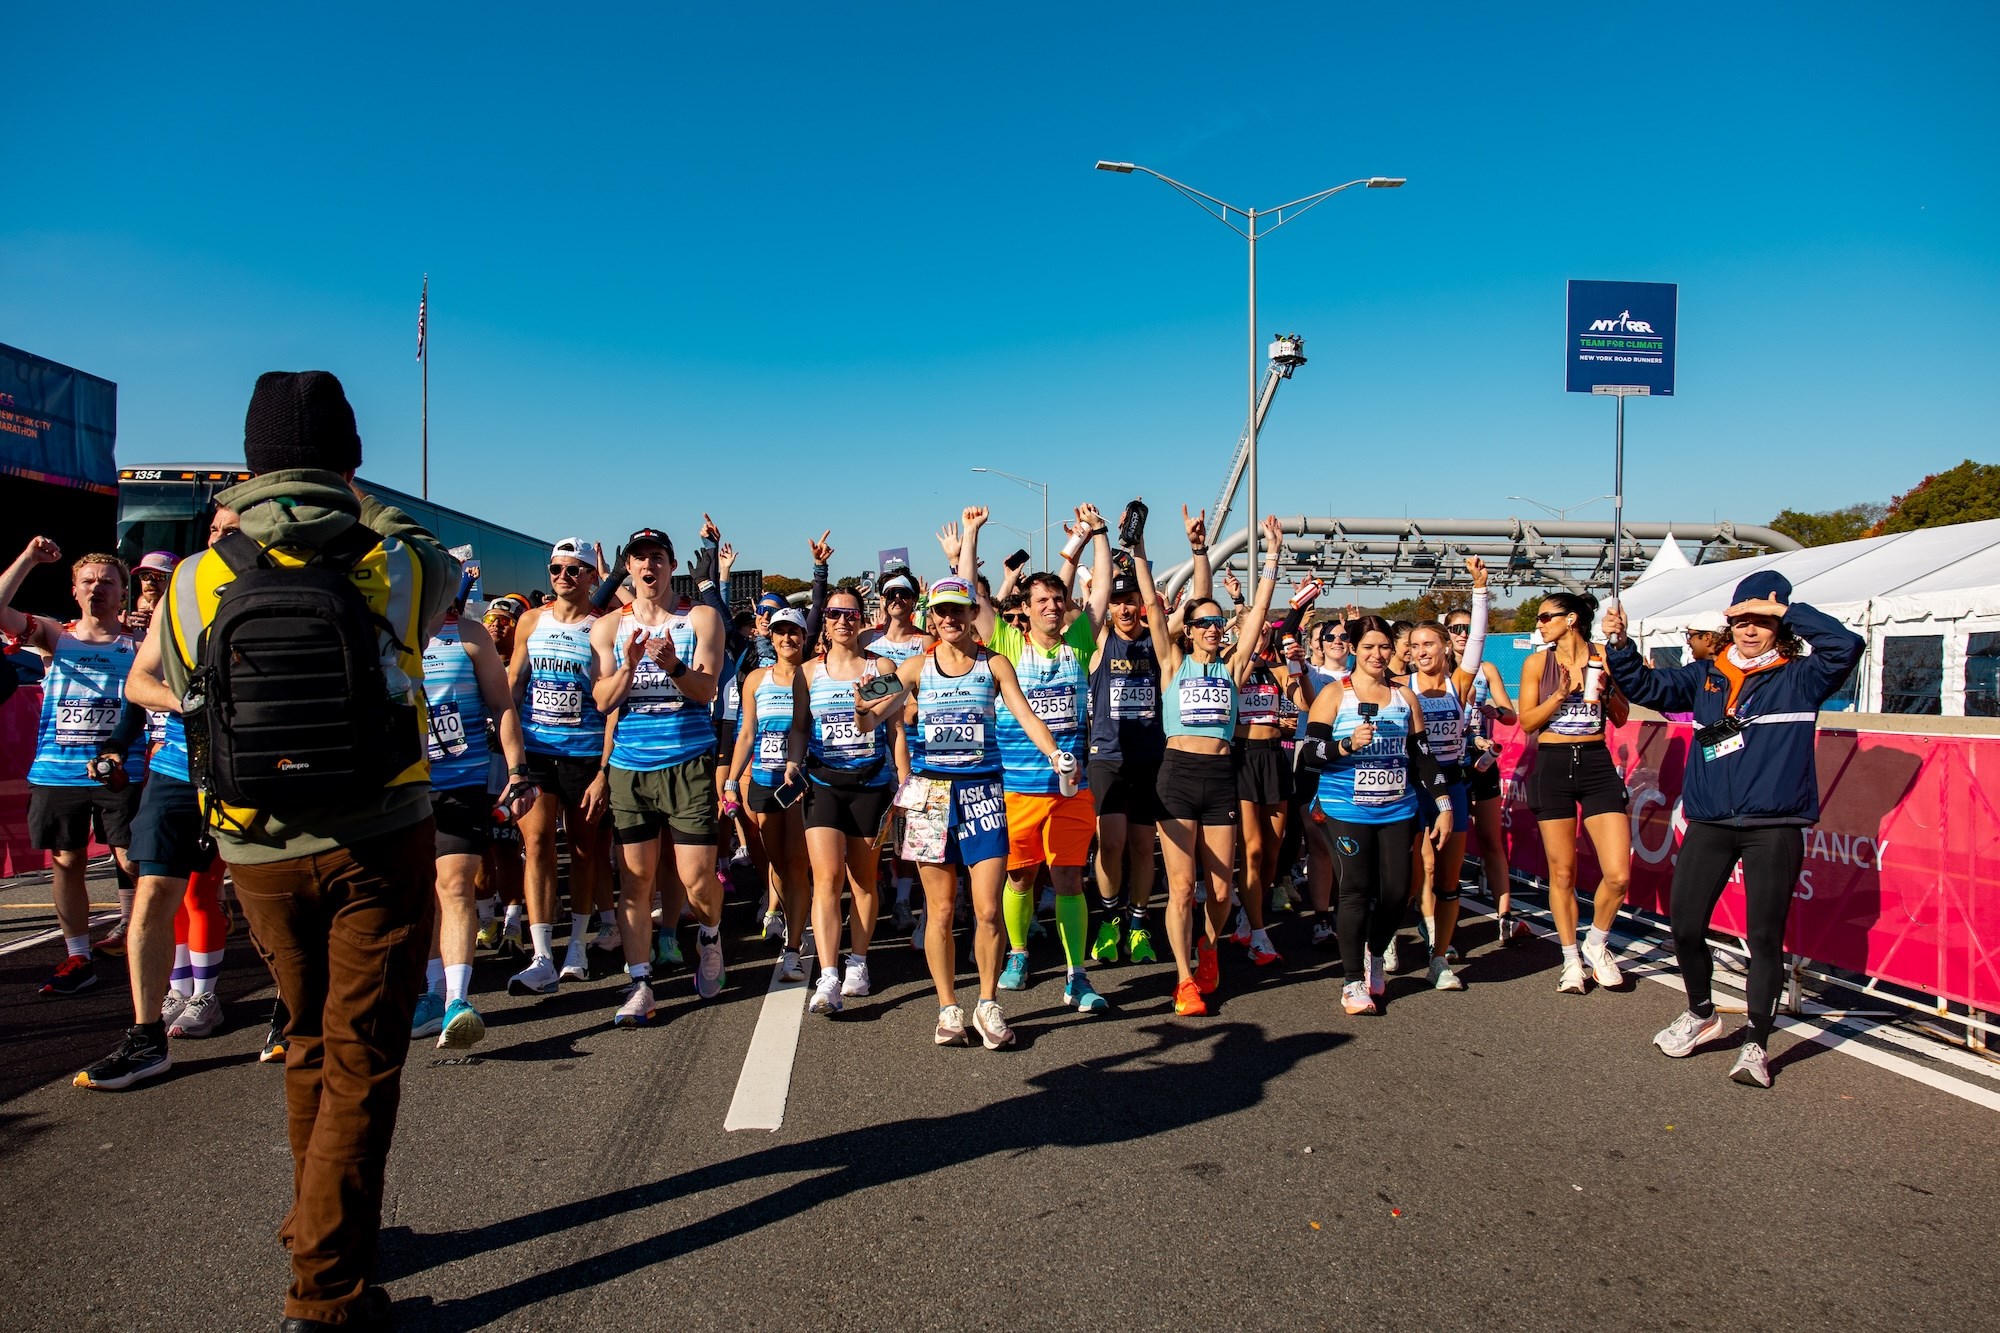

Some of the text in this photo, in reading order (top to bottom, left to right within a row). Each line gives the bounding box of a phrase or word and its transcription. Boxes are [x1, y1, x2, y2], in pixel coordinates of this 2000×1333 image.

[1580, 339, 1663, 349] TEAM FOR CLIMATE
[15, 413, 34, 427] YORK
[35, 419, 52, 431] CITY
[134, 470, 162, 480] 1354
[533, 657, 582, 675] NATHAN
[631, 674, 677, 690] 2544
[535, 690, 578, 707] 25526
[1113, 688, 1153, 702] 25459
[1182, 688, 1229, 704] 25435
[1245, 694, 1274, 707] 4857
[1031, 696, 1074, 714] 25554
[1422, 699, 1451, 710] ARAH
[61, 708, 116, 724] 25472
[826, 714, 839, 723] tcs
[931, 715, 944, 724] tcs
[934, 726, 974, 742] 8729
[1424, 721, 1457, 736] 5462
[763, 739, 789, 753] 254
[1357, 769, 1404, 785] 25606
[959, 786, 987, 805] ASK
[964, 796, 1004, 821] ABOUT
[957, 820, 977, 841] MY
[1800, 827, 1889, 872] TANCY
